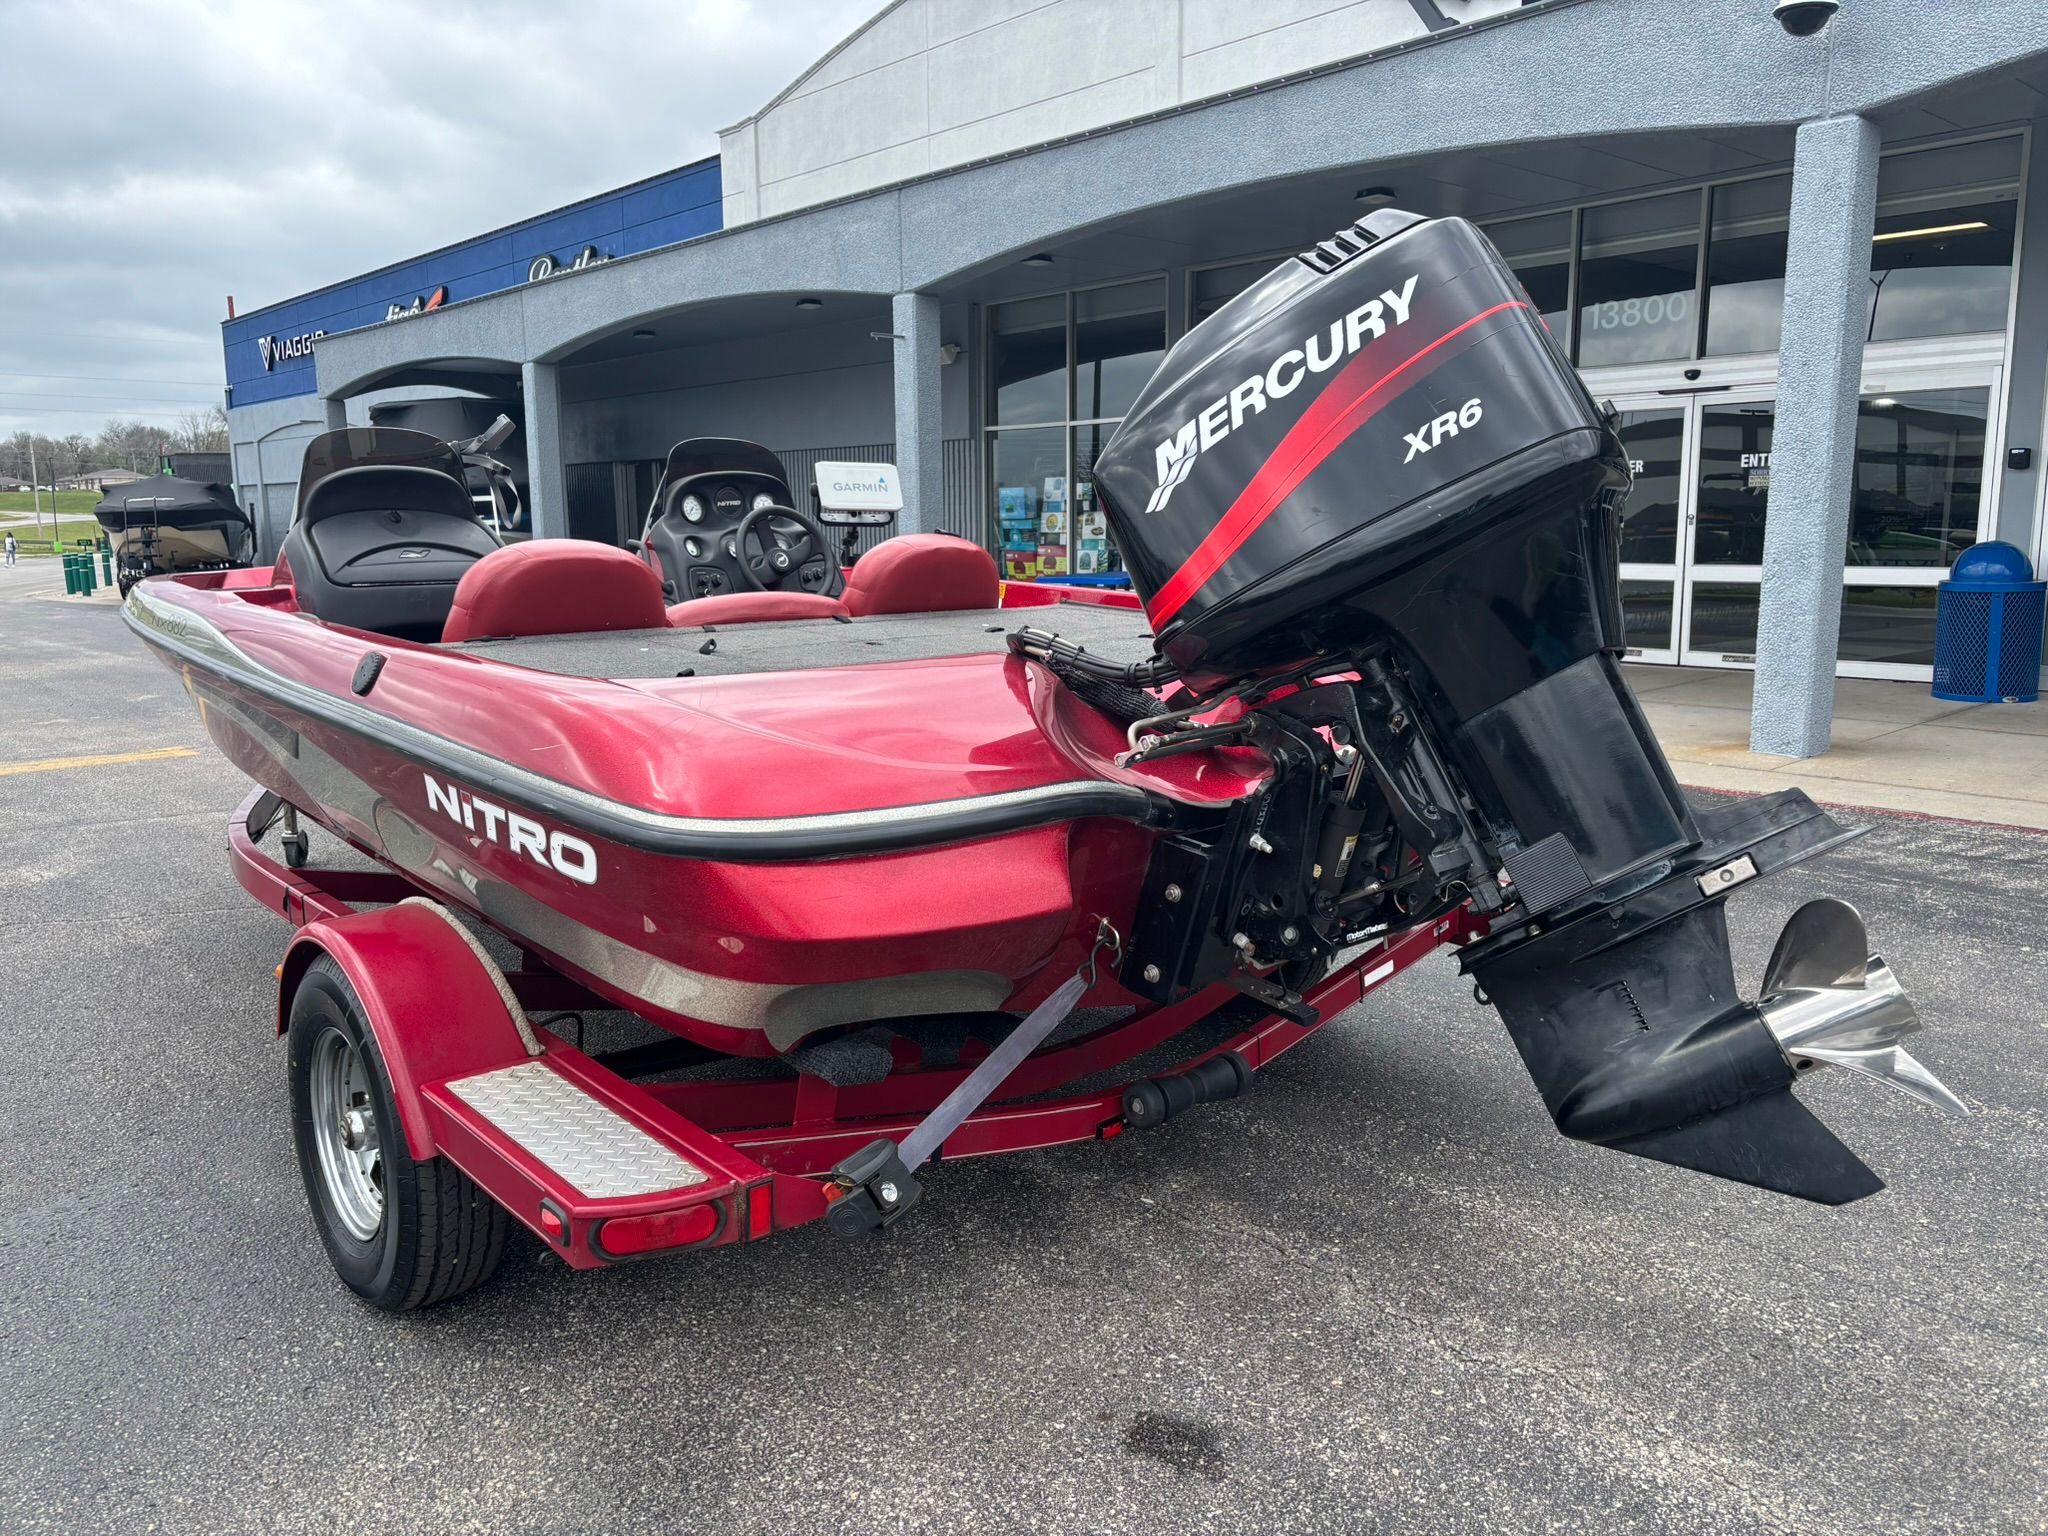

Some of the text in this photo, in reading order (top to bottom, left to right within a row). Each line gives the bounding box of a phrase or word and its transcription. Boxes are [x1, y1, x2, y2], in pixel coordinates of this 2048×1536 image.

[1590, 293, 1687, 330] 13800
[1145, 274, 1419, 514] MERCURY
[1403, 398, 1482, 464] XR6
[833, 482, 888, 492] GARMIN
